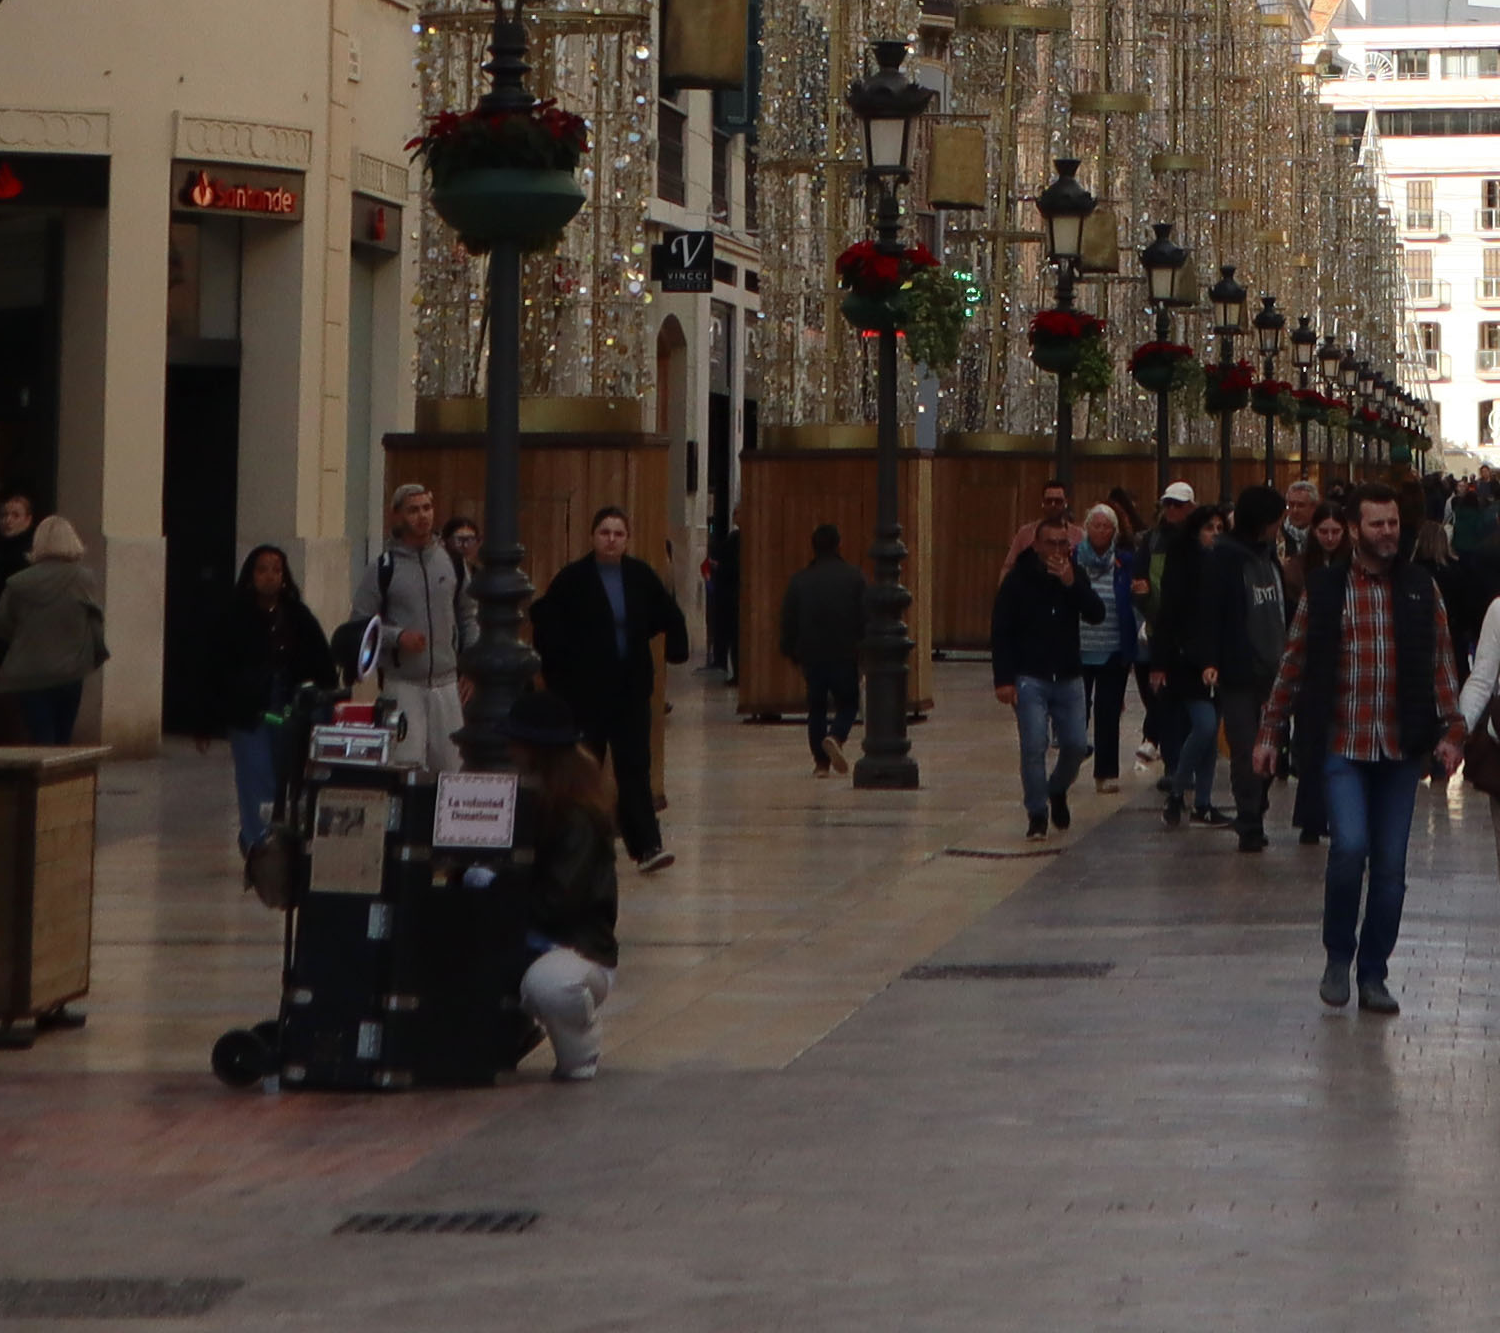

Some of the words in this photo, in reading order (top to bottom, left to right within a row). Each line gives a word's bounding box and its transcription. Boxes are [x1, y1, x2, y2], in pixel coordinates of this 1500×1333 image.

[214, 177, 299, 214] Santander
[667, 271, 708, 281] VINCCI
[448, 797, 460, 808] La
